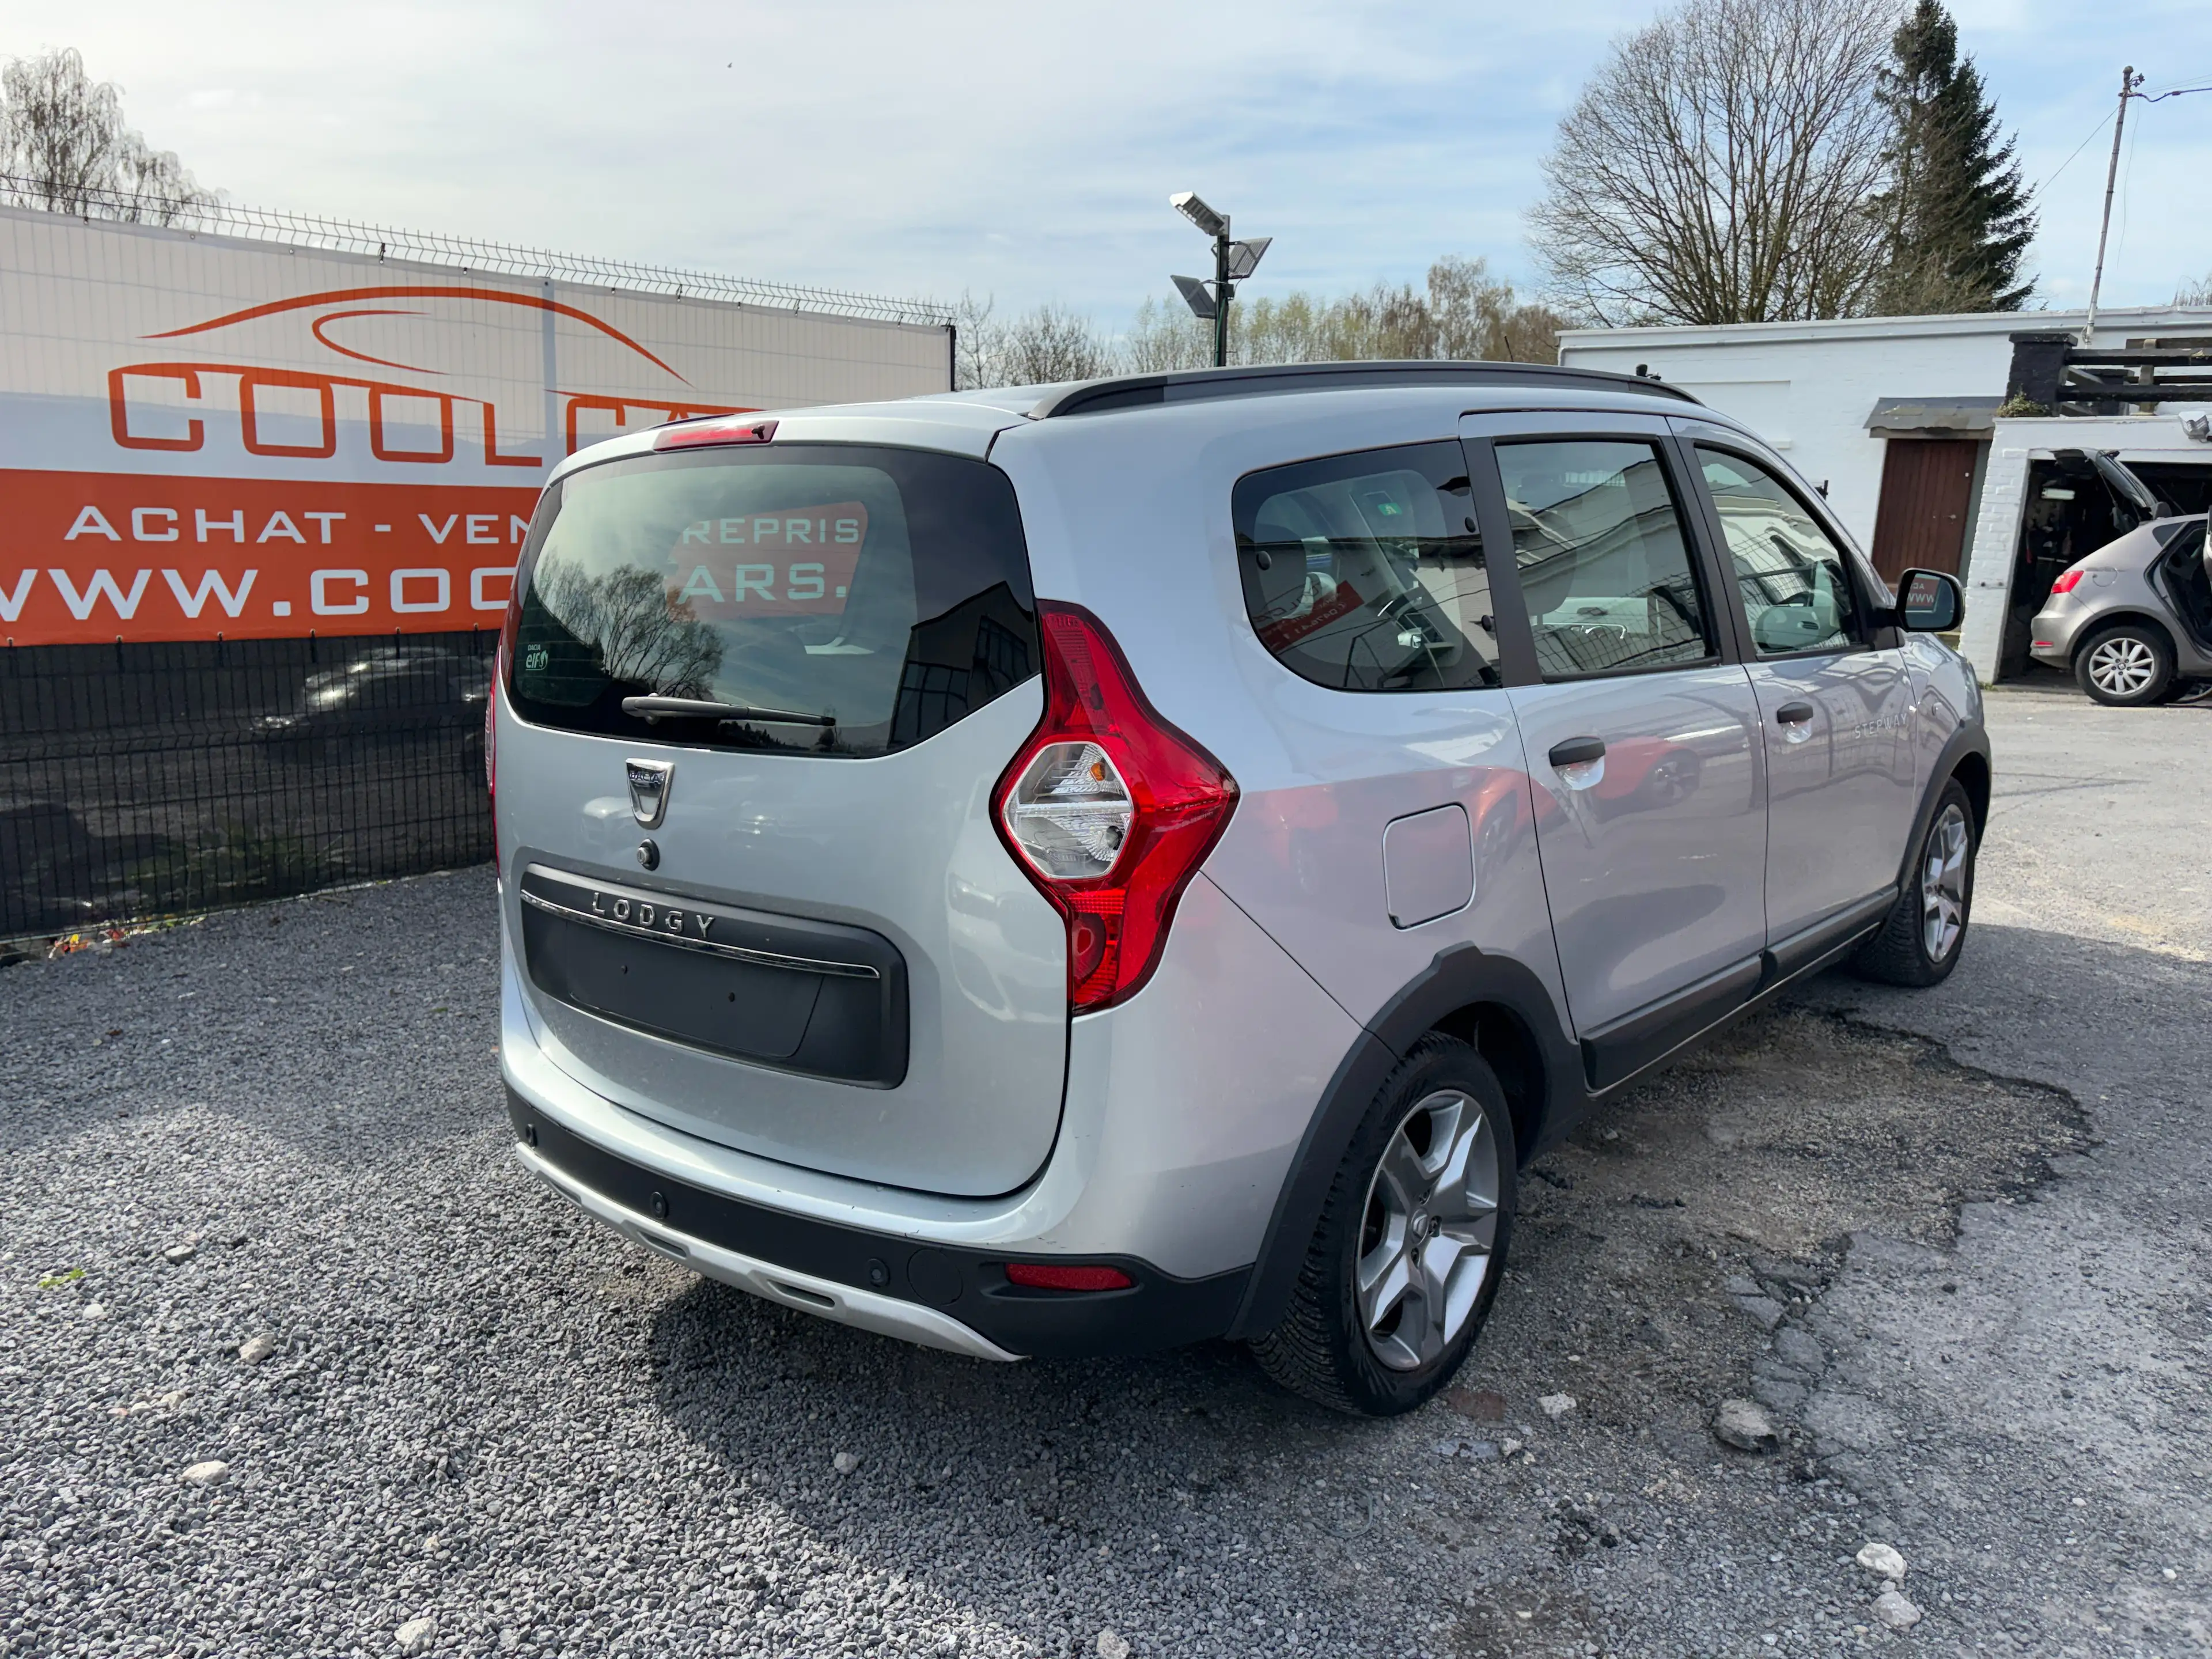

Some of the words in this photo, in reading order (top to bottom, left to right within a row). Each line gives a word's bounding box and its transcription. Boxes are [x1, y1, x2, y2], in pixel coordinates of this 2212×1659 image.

[64, 505, 346, 544] ACHAT
[683, 518, 859, 544] REPRIS
[1854, 713, 1909, 740] STEPWAY
[592, 892, 715, 938] LODGY
